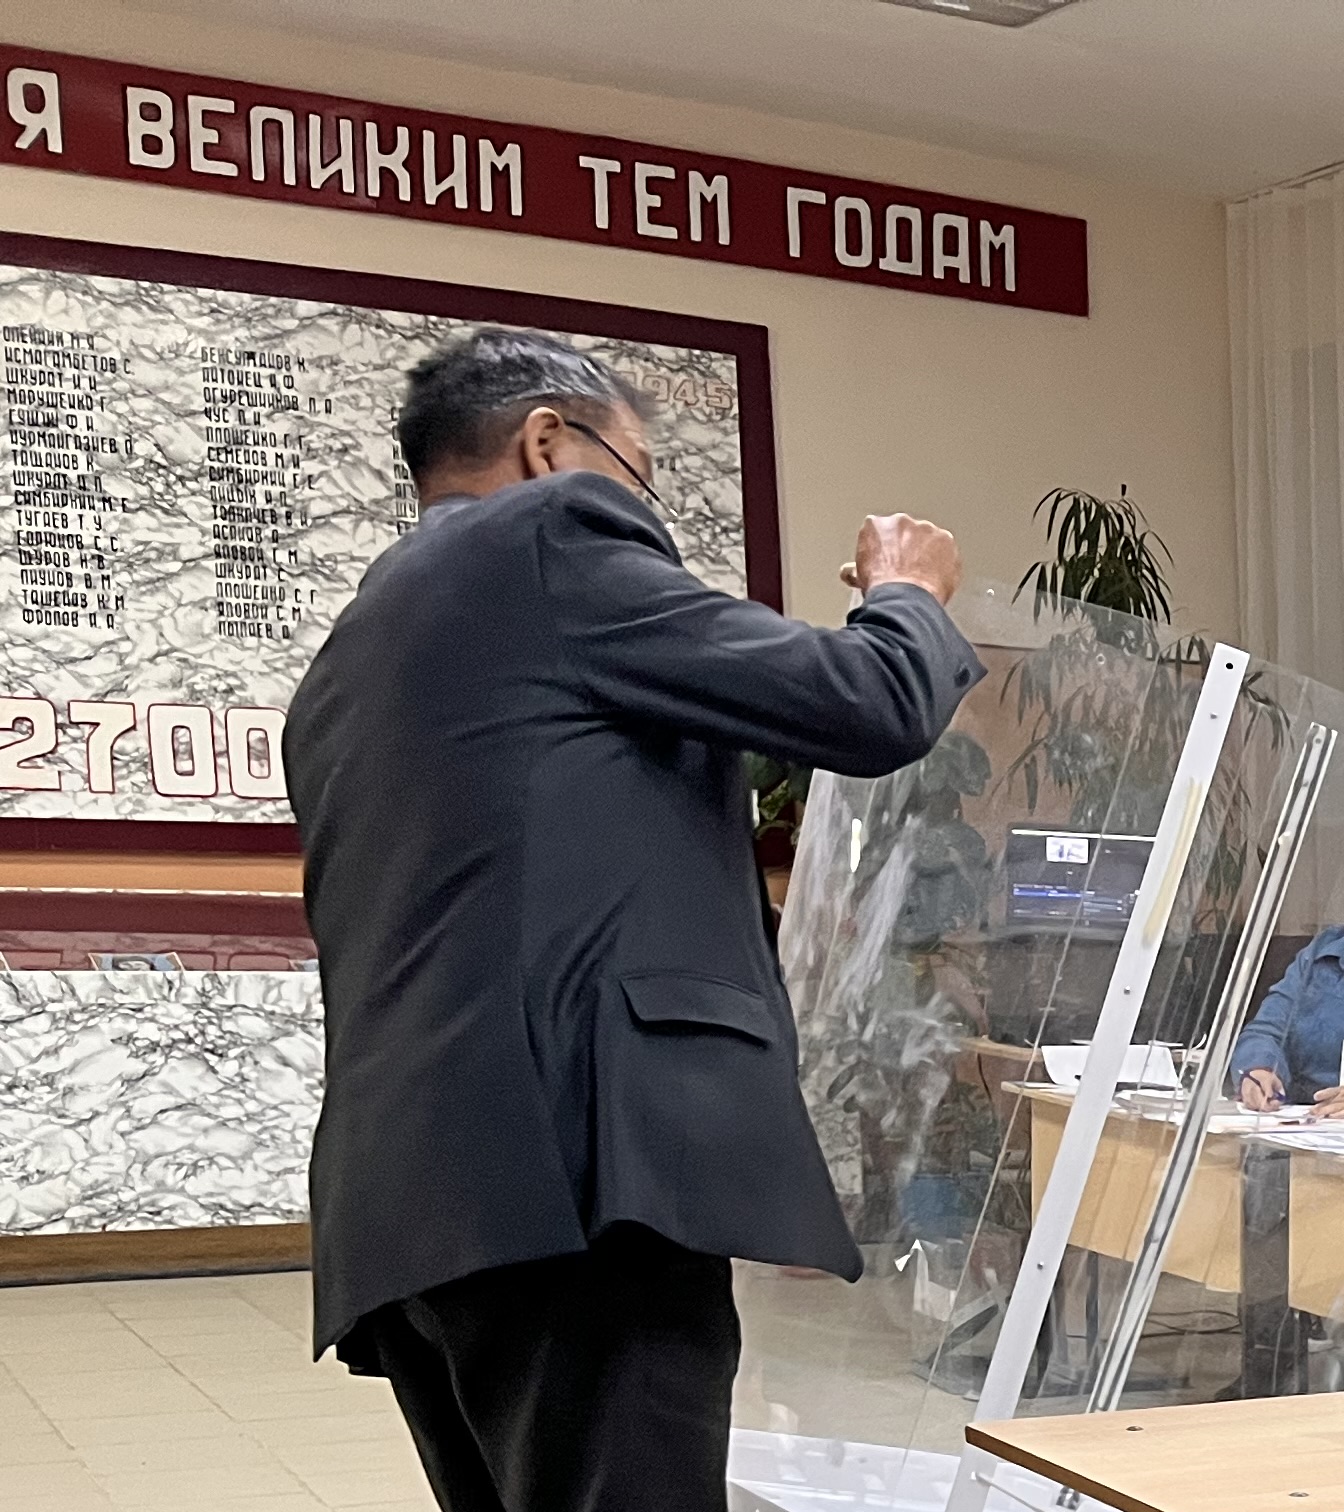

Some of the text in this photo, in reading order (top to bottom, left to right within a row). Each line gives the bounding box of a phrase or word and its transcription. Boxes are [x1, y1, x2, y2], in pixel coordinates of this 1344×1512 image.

[126, 86, 523, 217] ВЕЛИКИМ
[579, 155, 732, 245] ТЕМ
[785, 187, 1017, 292] ГОДАМ
[5, 346, 116, 373] ИСМАГАМБЕТОВ
[6, 367, 63, 387] ШКУРАТ
[7, 389, 93, 410] МАРУШЕНКО
[10, 429, 117, 453] НУРМАНГАЗИЕВ
[208, 446, 267, 466] СЕМЕНОВ
[13, 470, 67, 489] ШКУРАТ
[16, 510, 68, 529] ТУГАЕВ
[215, 563, 267, 581] ШКУРАТ
[23, 609, 79, 627] ФРОЛОВ
